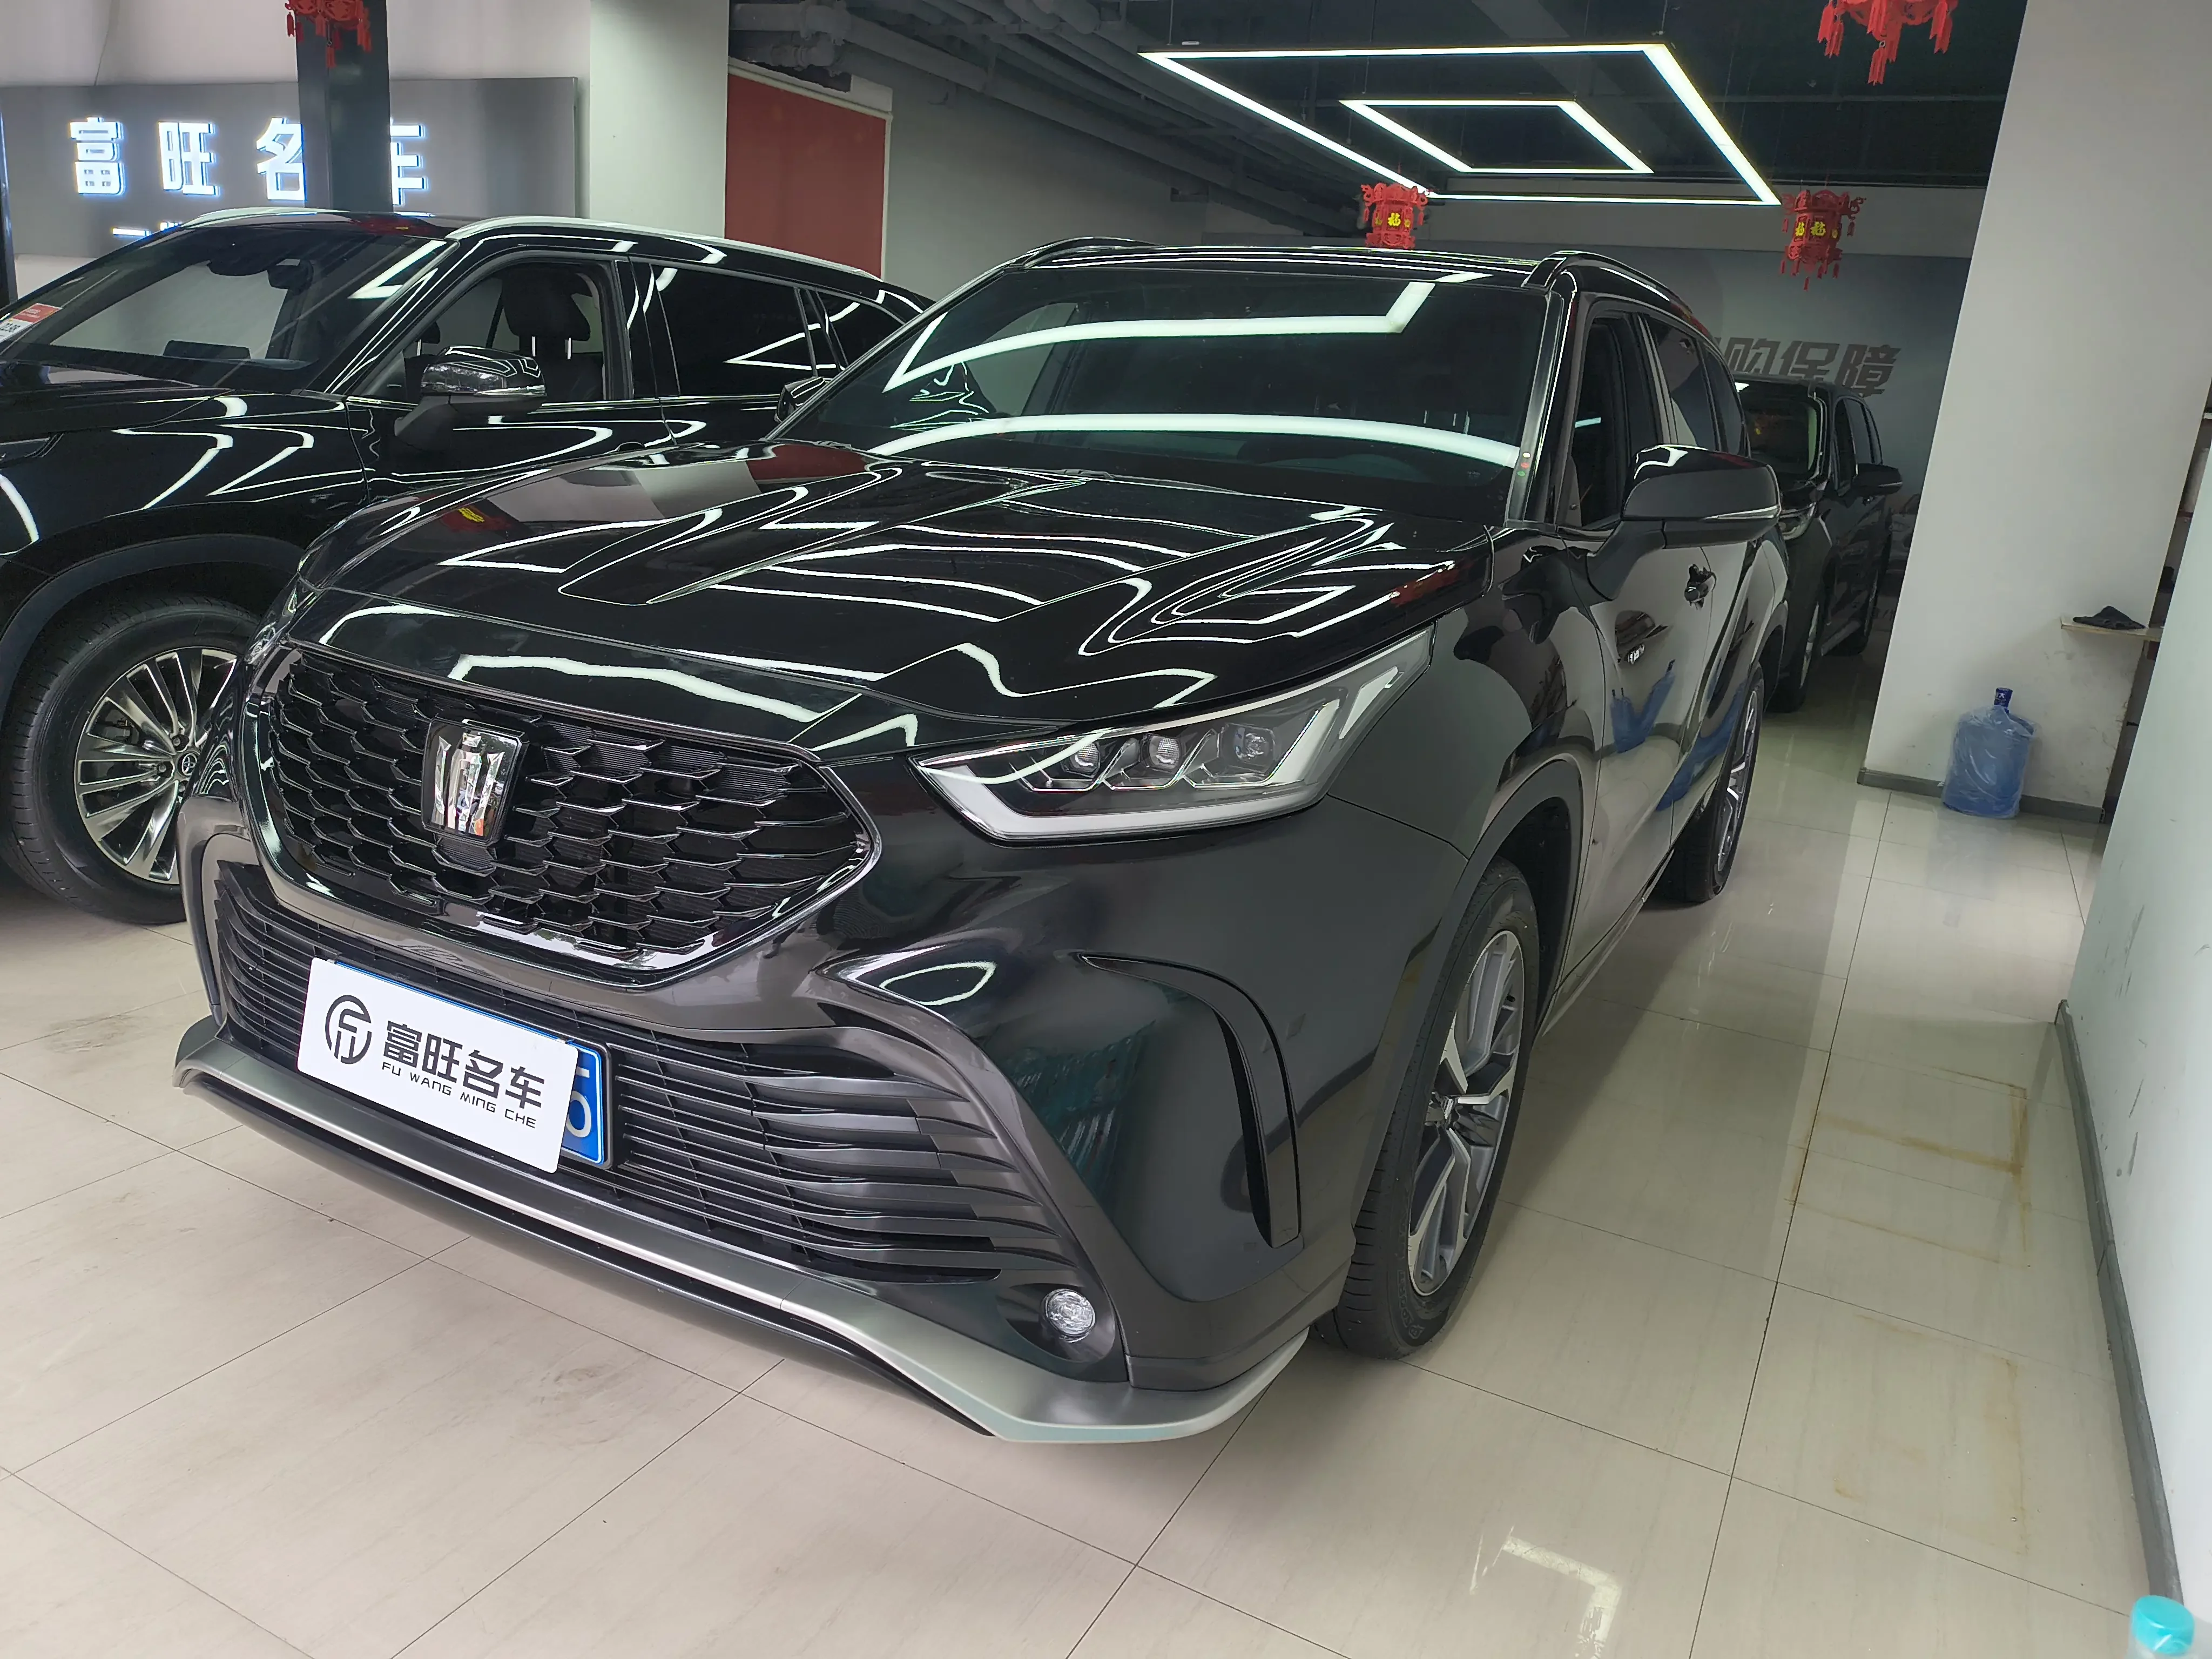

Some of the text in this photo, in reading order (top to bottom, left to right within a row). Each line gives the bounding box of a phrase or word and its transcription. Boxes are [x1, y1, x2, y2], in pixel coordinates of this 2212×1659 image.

[1715, 337, 1901, 398] 购保障
[382, 1062, 536, 1129] FU WANG MING CHE
[383, 1021, 545, 1109] 富旺名车
